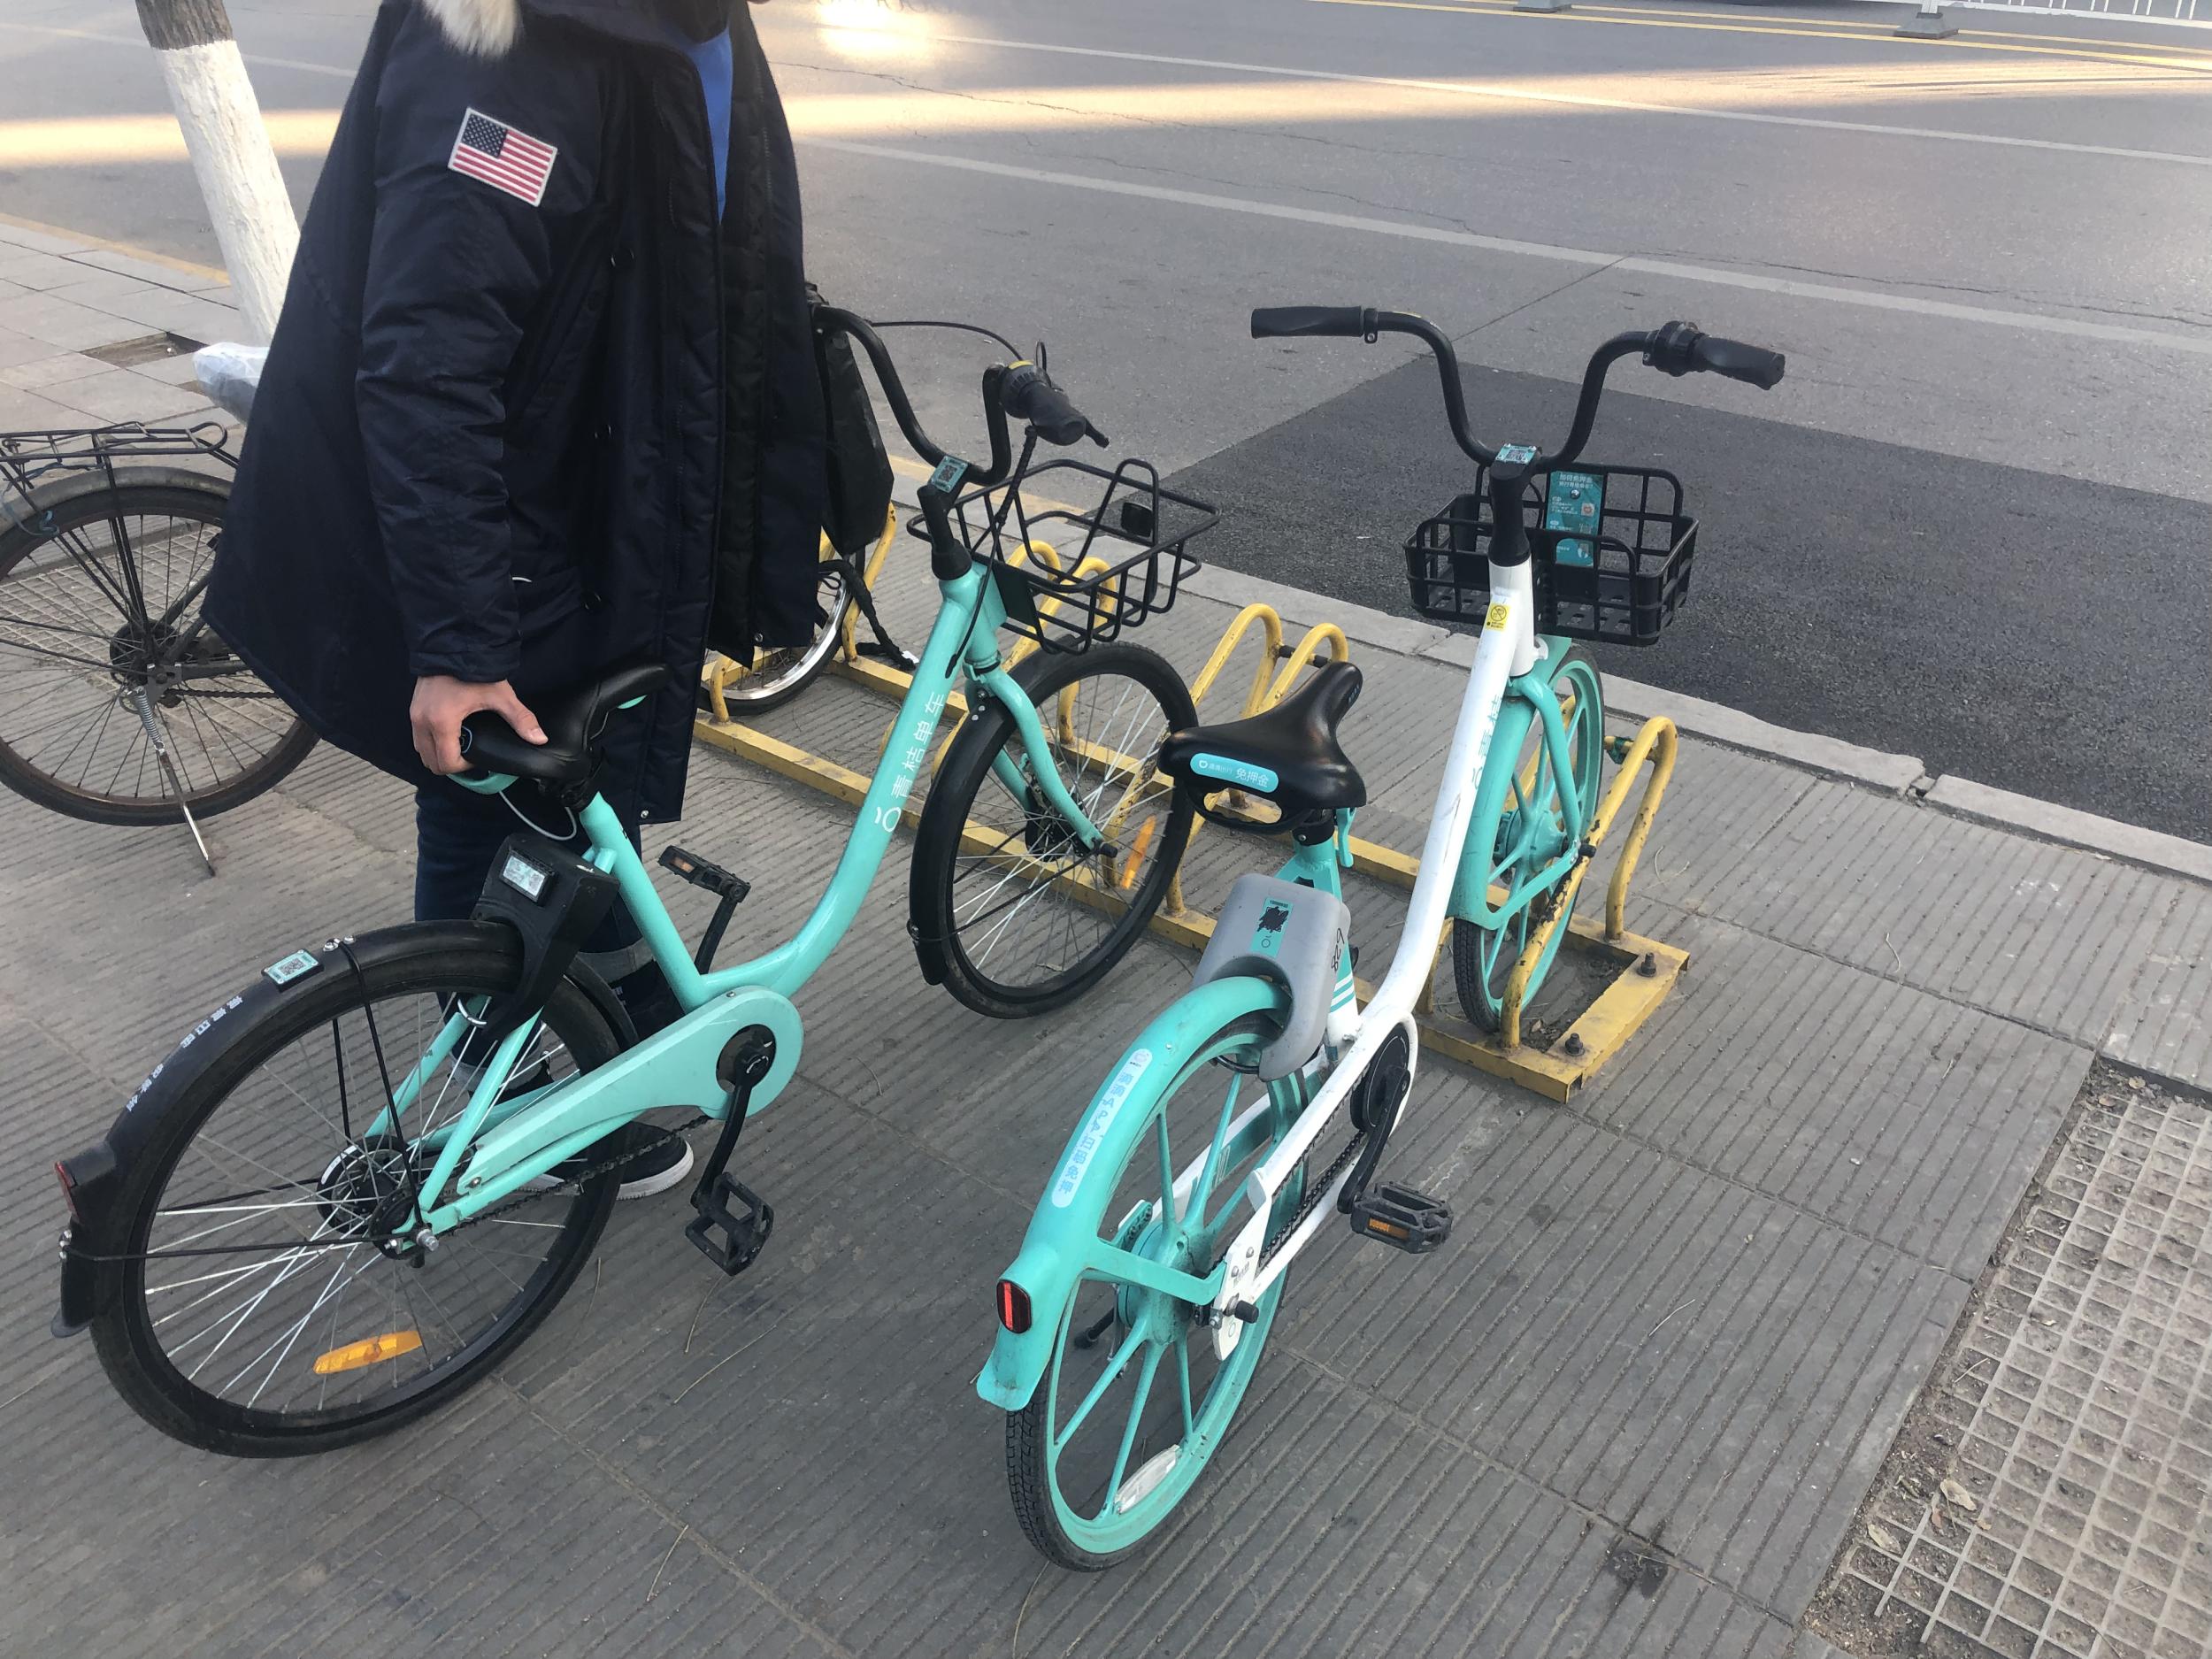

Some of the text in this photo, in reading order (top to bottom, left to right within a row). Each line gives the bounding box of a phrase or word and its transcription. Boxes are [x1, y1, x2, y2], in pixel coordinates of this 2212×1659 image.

[891, 691, 945, 799] 青桔单车
[1235, 767, 1269, 787] 免押金
